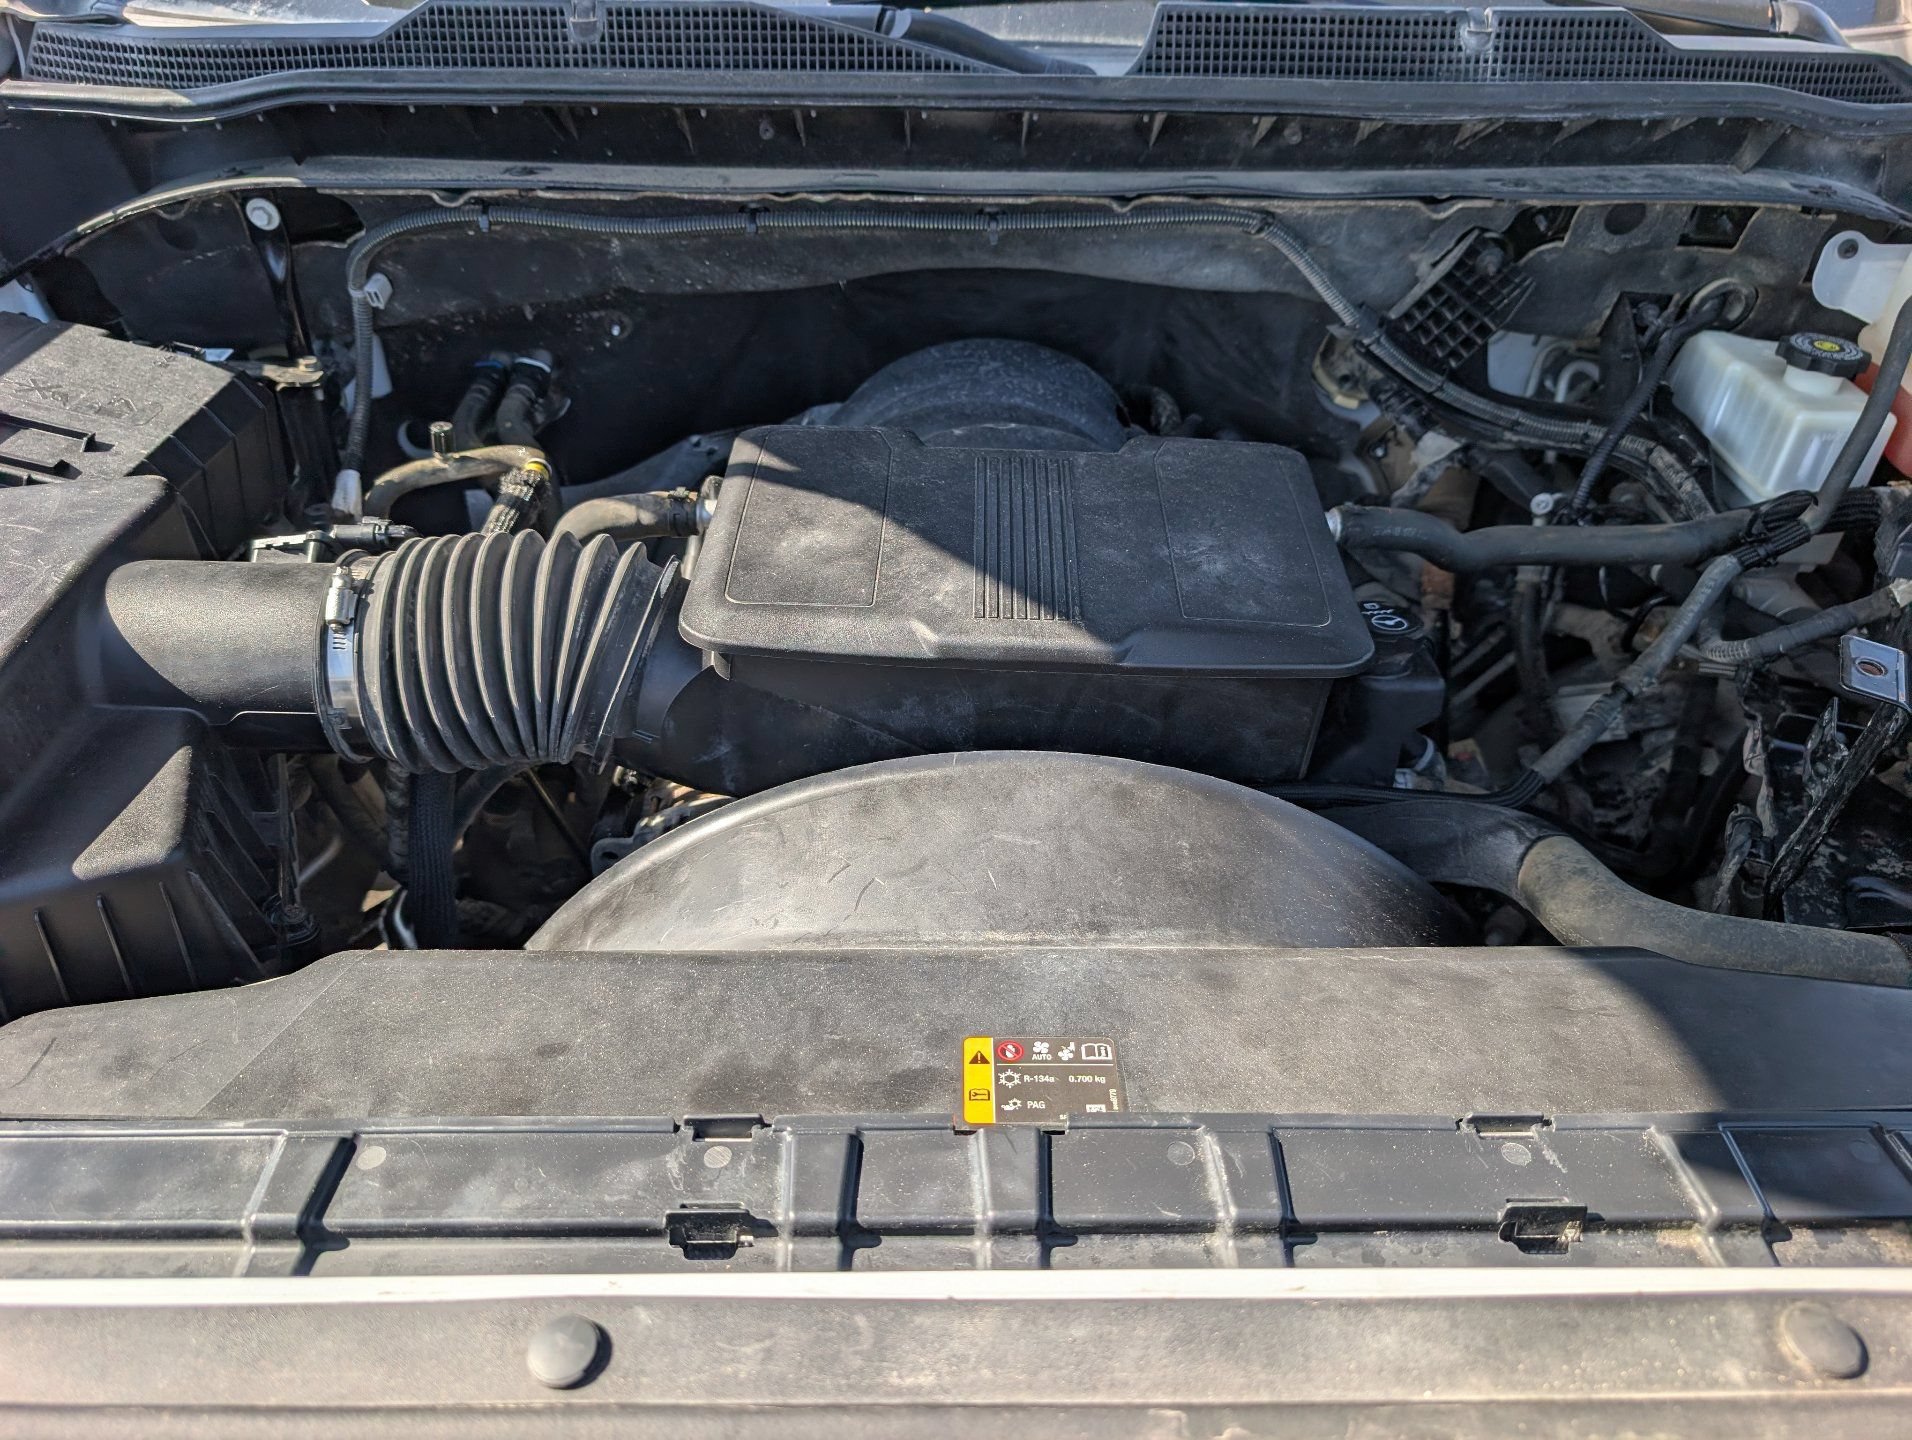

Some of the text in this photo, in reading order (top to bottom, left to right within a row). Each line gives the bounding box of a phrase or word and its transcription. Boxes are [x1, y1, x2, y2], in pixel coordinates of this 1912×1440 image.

[1032, 1053, 1052, 1061] AUTO
[1023, 1075, 1055, 1083] R-134a
[1095, 1075, 1106, 1084] kg
[1027, 1101, 1046, 1109] PAG
